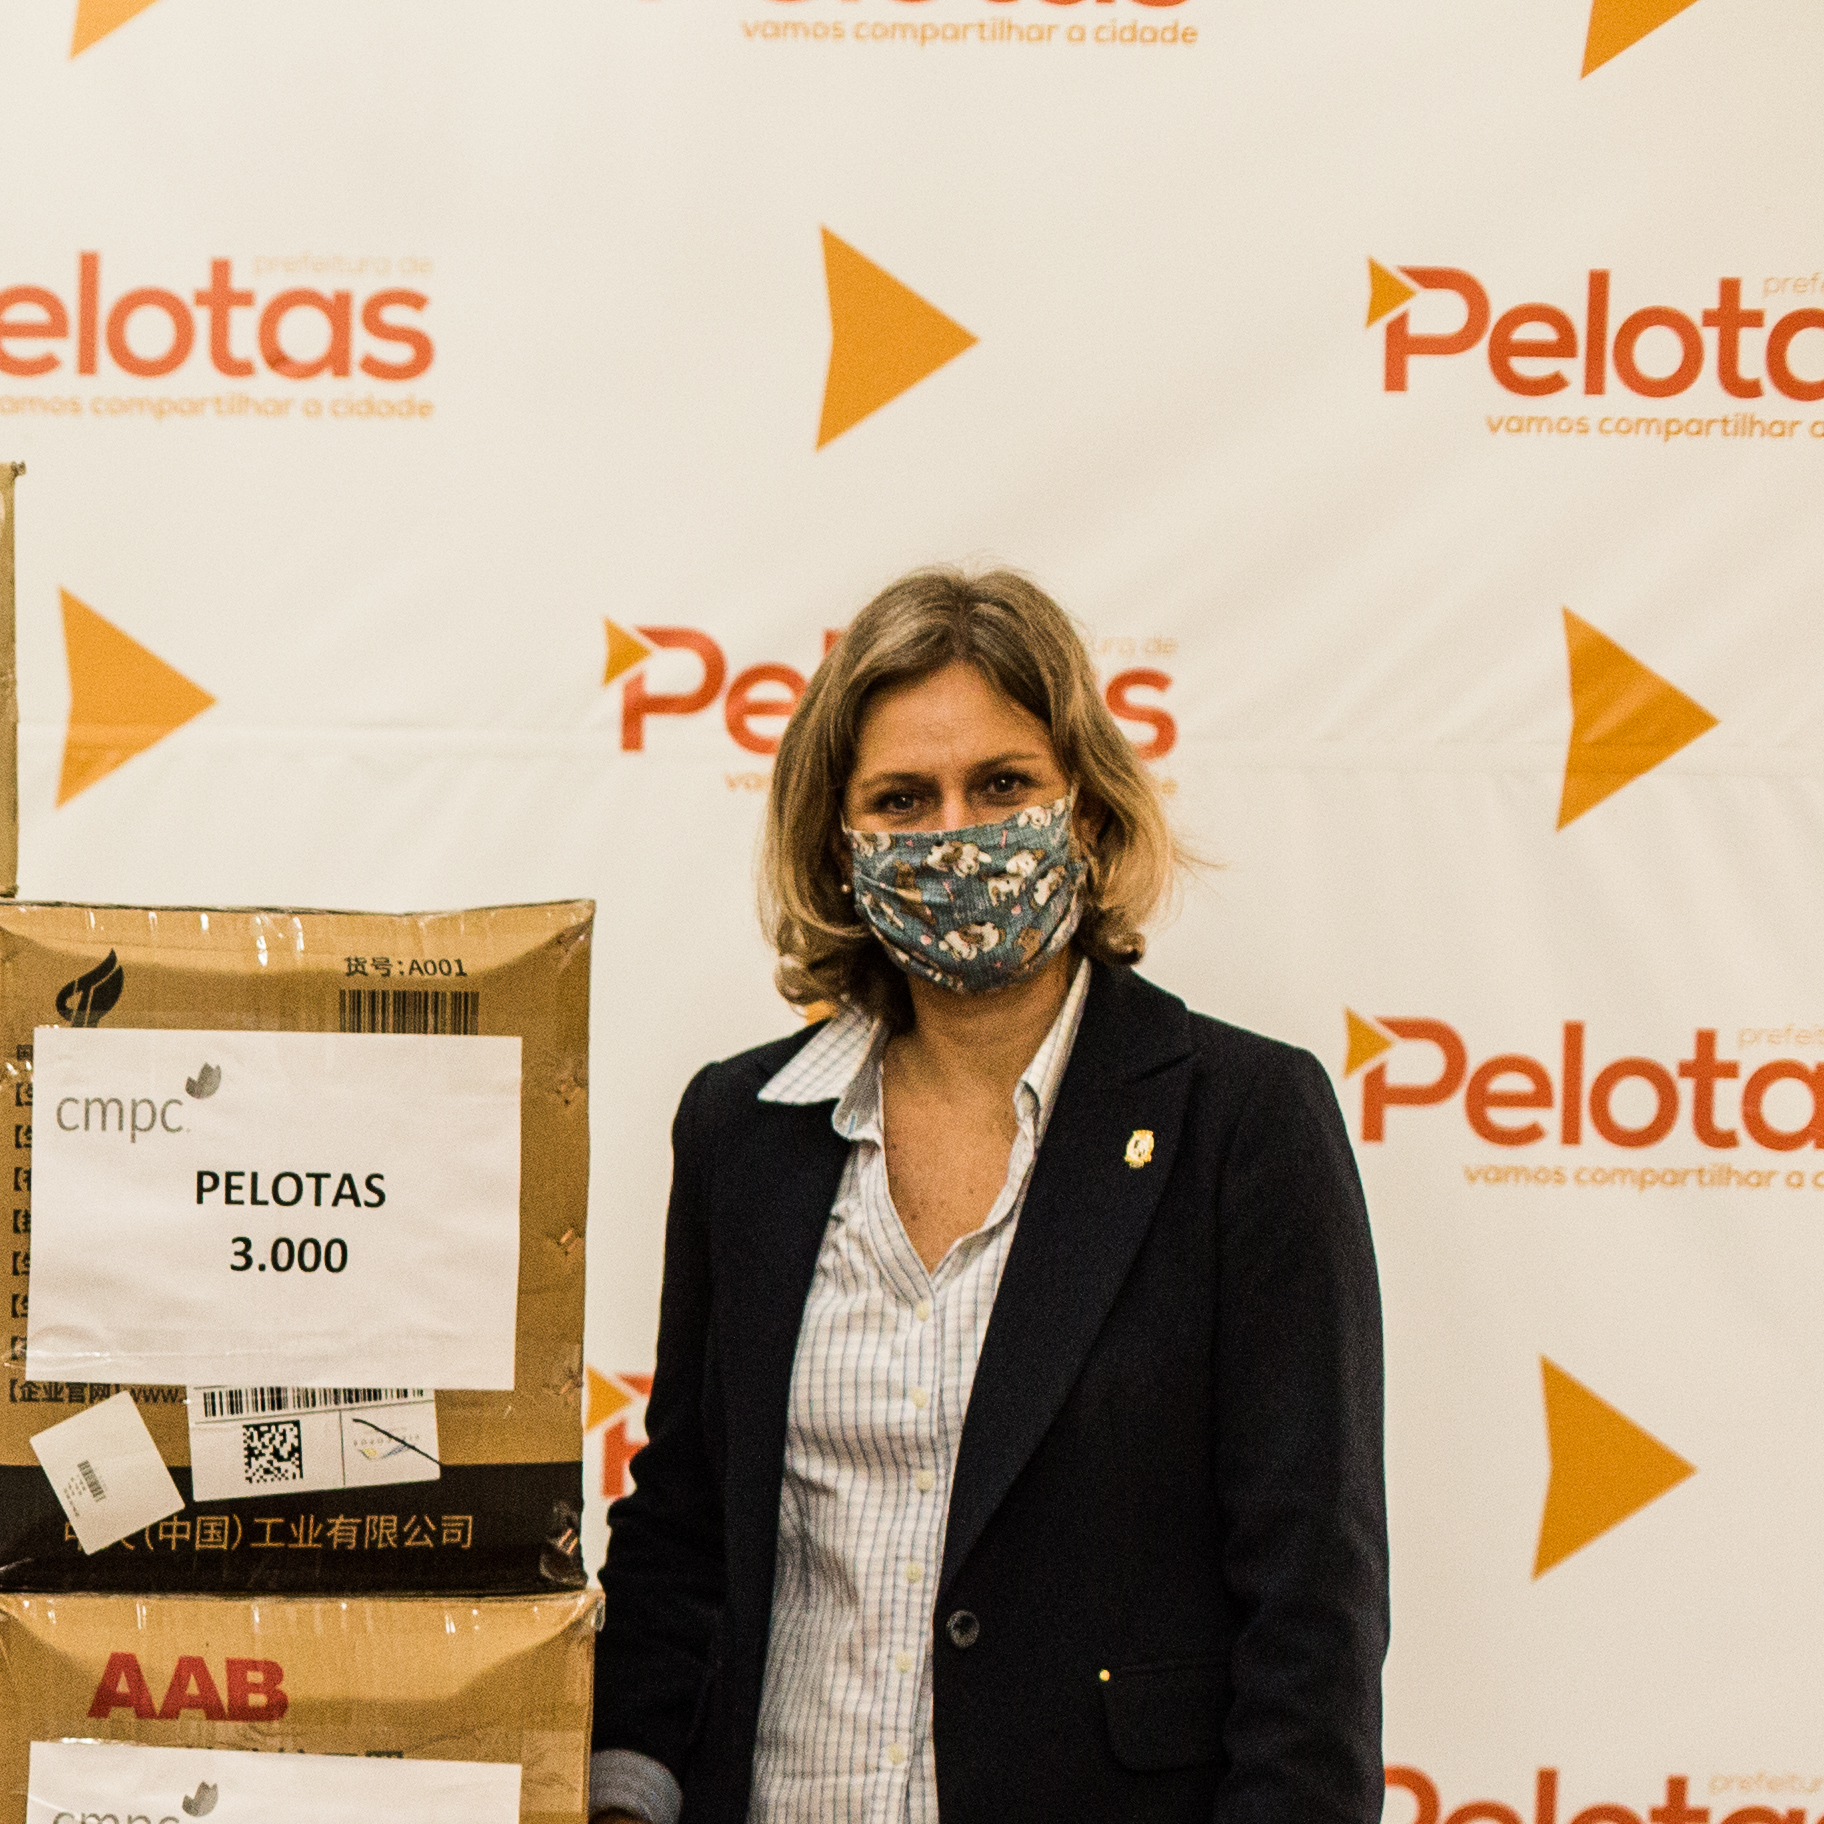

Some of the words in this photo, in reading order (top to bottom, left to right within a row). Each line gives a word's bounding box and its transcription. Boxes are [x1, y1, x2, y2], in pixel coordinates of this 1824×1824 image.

[742, 20, 845, 40] vamos
[855, 18, 1058, 46] compartilhar
[1067, 21, 1086, 43] a
[1094, 18, 1198, 44] cidade
[1384, 265, 1824, 401] Pelota
[90, 391, 291, 420] compartilhar
[303, 396, 322, 418] a
[331, 392, 434, 419] cidade
[1486, 415, 1589, 435] vamos
[1598, 412, 1802, 442] compartilhar
[1362, 1016, 1824, 1151] Pelota
[56, 1096, 183, 1143] cmpc
[196, 1171, 386, 1209] PELOTAS
[1464, 1164, 1565, 1185] vamos
[1574, 1161, 1777, 1192] compartilhar
[229, 1236, 348, 1274] 3.000
[64, 1514, 473, 1552] （中国）工业有限公司
[87, 1651, 290, 1722] AAB
